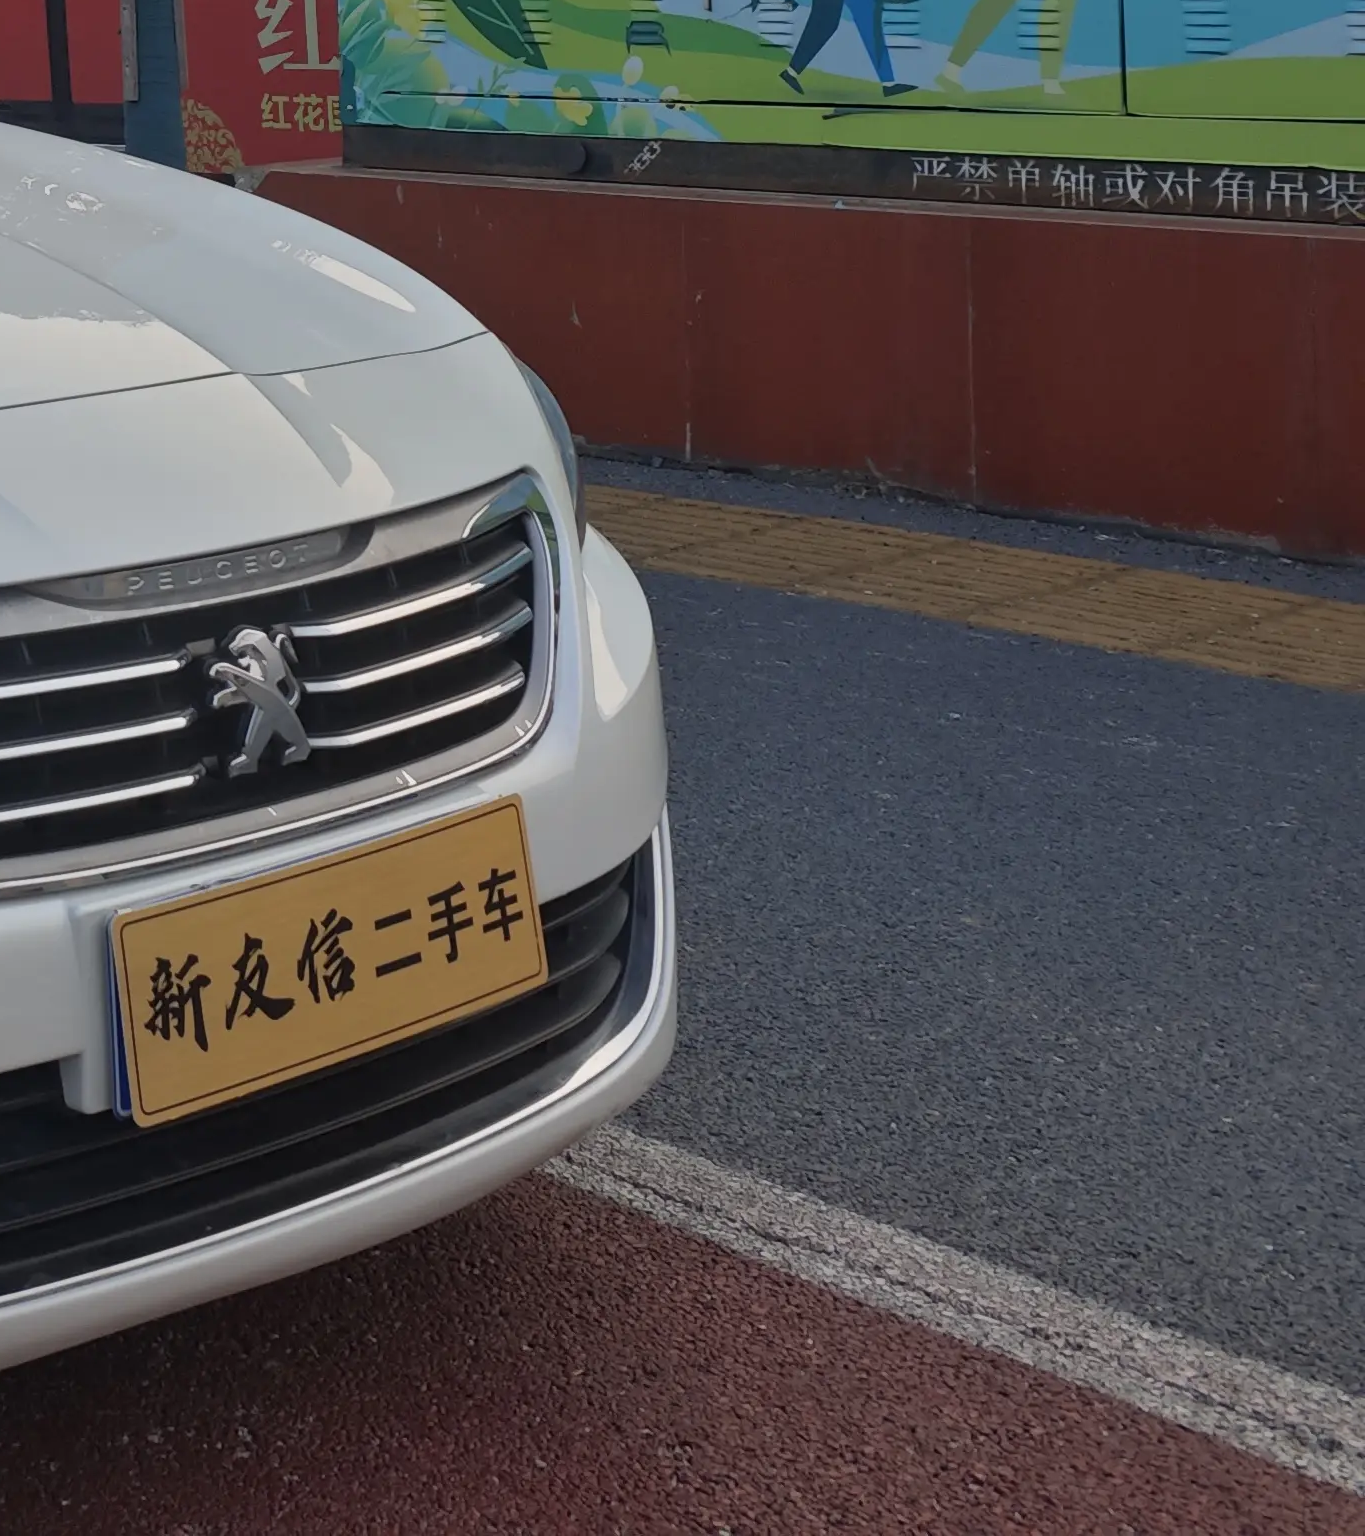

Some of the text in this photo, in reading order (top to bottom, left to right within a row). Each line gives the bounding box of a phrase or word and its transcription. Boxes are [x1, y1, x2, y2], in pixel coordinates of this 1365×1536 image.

[910, 155, 1365, 221] 严禁单轴或对角吊装
[142, 866, 525, 1052] 新友信二手车
